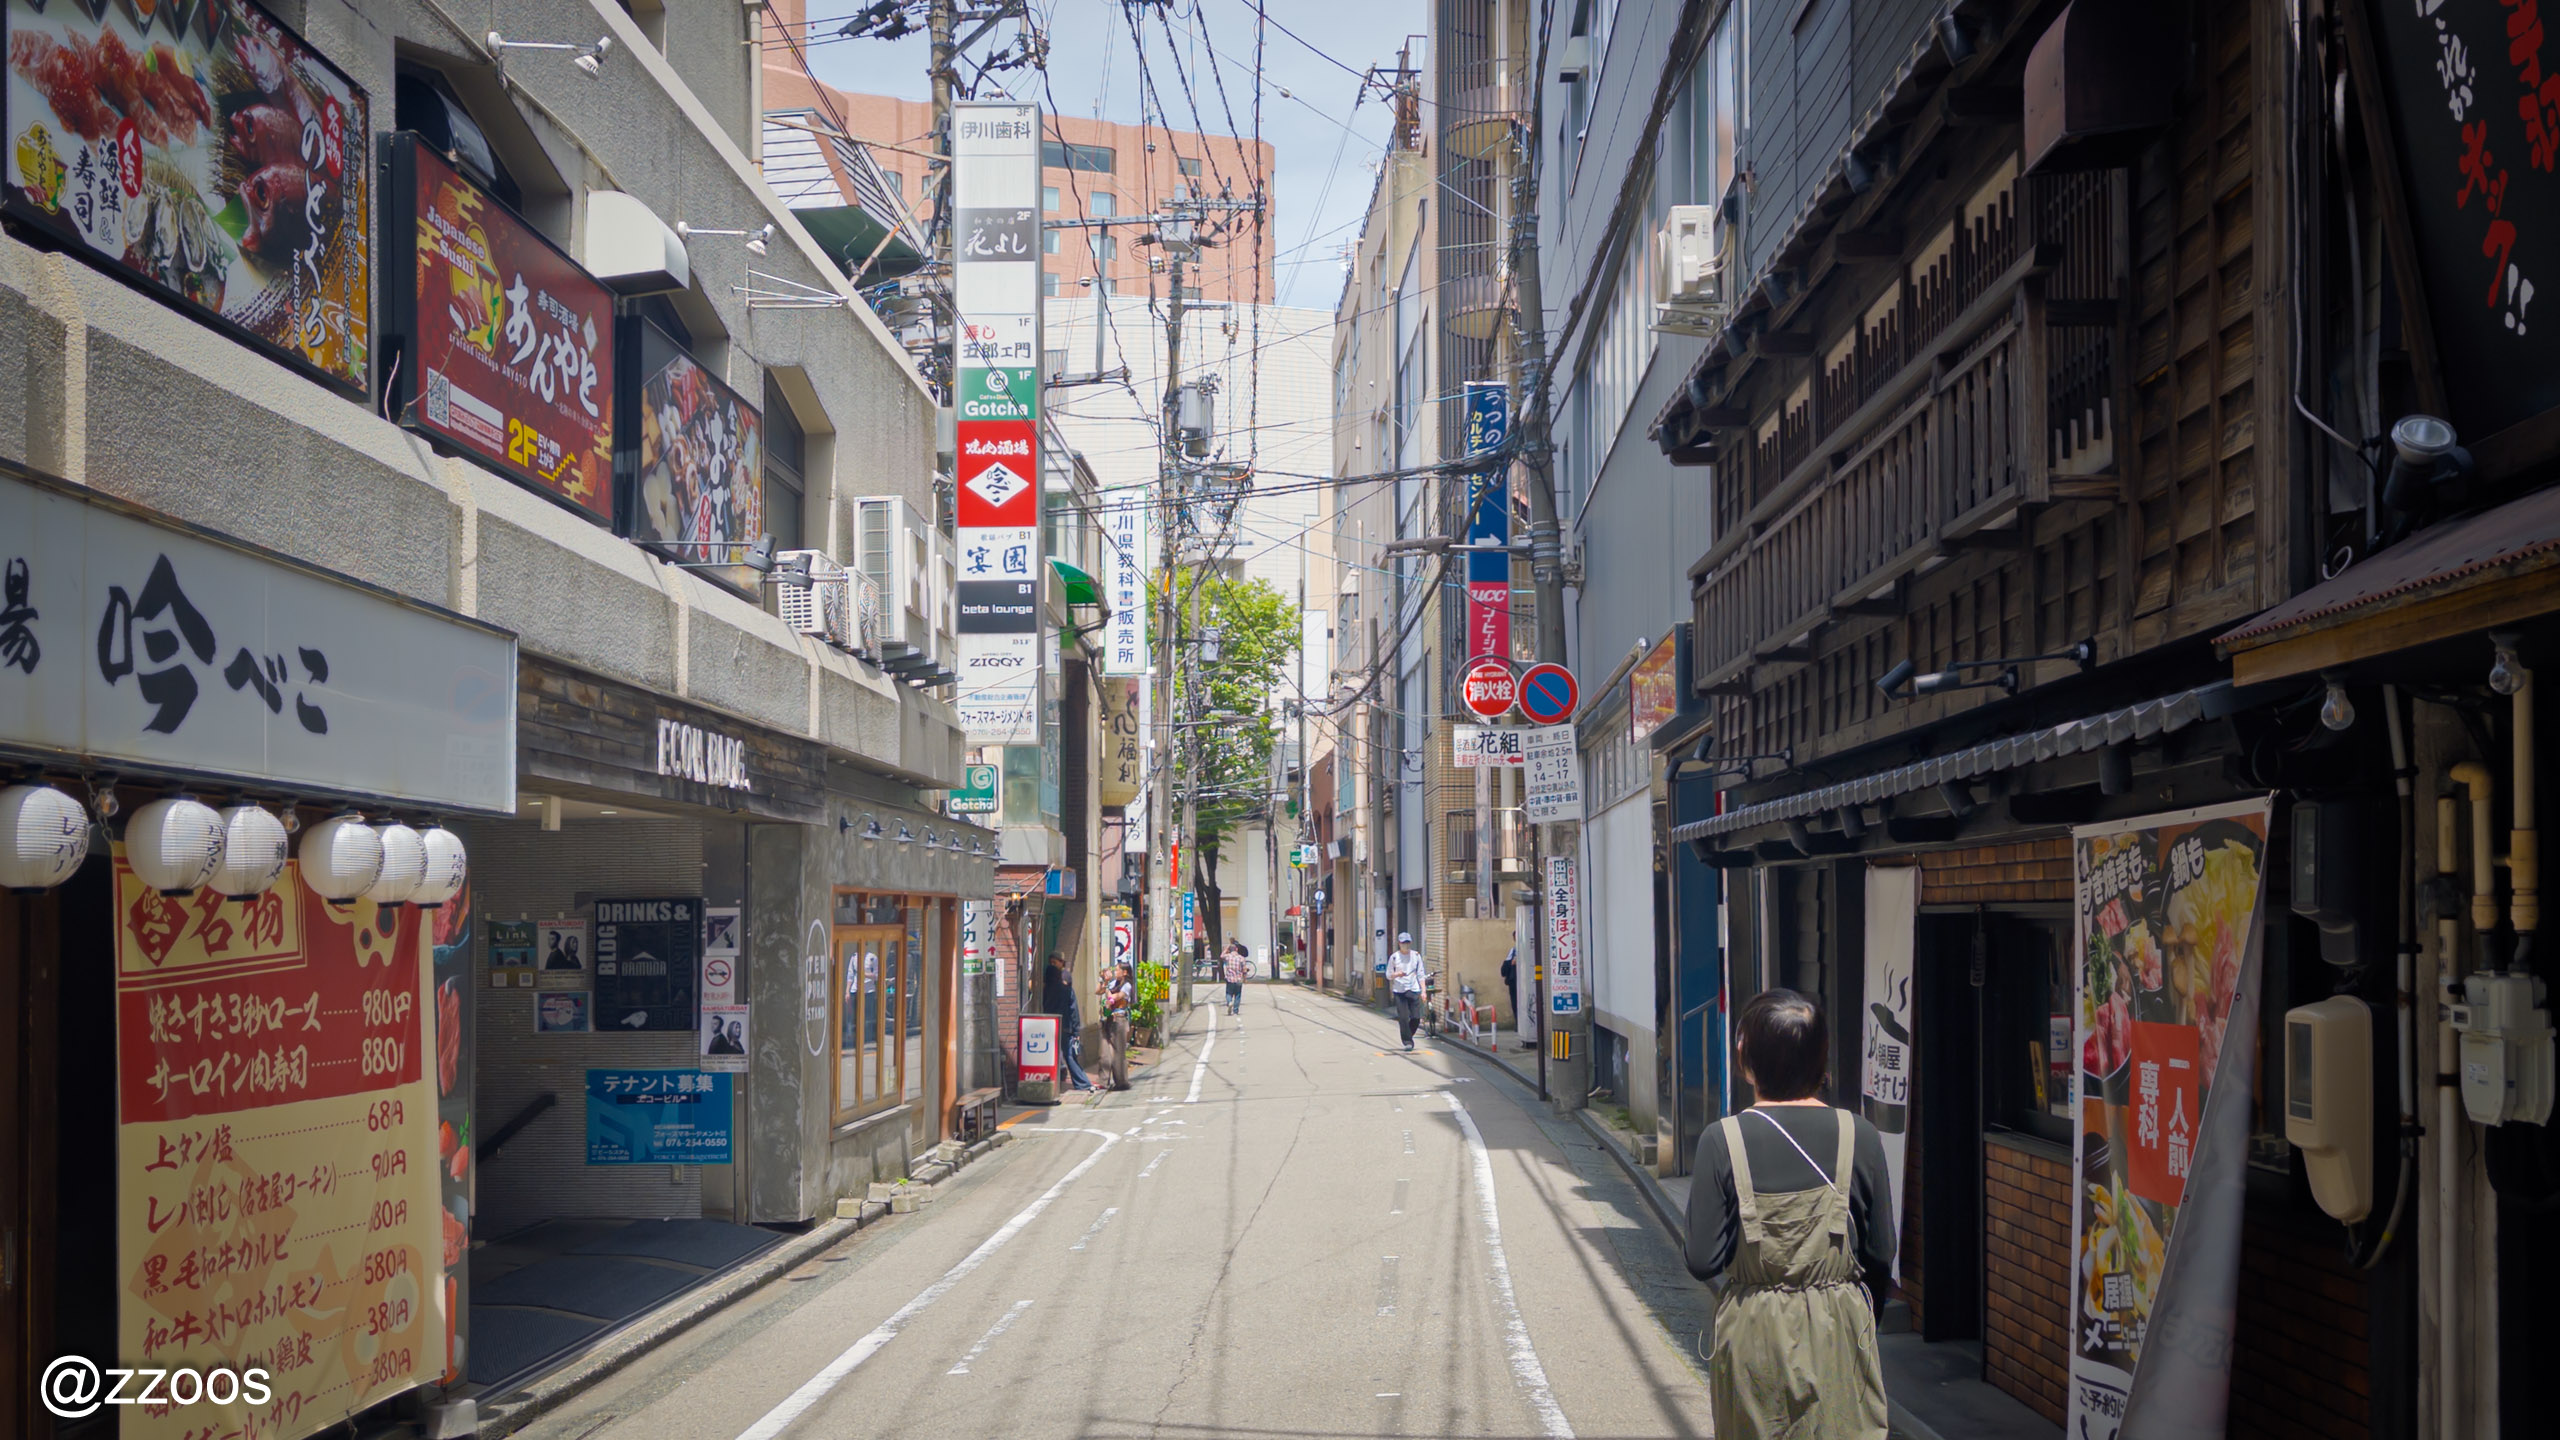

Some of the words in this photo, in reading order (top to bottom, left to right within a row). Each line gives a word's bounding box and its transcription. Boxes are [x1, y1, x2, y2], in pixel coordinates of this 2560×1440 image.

[960, 120, 1031, 139] 伊川歯科
[1016, 107, 1030, 117] 3F
[327, 103, 341, 170] 名物
[122, 127, 139, 192] 人気
[73, 145, 97, 234] 寿司
[301, 110, 327, 347] のどぐろ
[426, 205, 486, 260] Japanese
[1017, 211, 1031, 221] 2F
[439, 239, 475, 278] Sushi
[964, 228, 1027, 256] 花よし
[293, 248, 301, 345] NODOGURO
[1019, 317, 1031, 327] 1F
[505, 272, 600, 418] あんやと
[501, 364, 528, 389] ANYATO
[1018, 370, 1032, 381] 1F
[964, 400, 1029, 417] Gotcha
[508, 417, 538, 468] 2F
[986, 466, 1011, 503] 吟べこ
[1019, 531, 1031, 541] B1
[1019, 583, 1032, 594] B1
[962, 604, 990, 614] beta
[992, 604, 1034, 614] lounge
[98, 553, 329, 735] 吟べこ
[970, 657, 1025, 667] ZIGGY
[1469, 680, 1513, 702] 消火栓
[951, 797, 994, 811] Gotcha
[2170, 837, 2205, 890] 鍋も
[187, 885, 284, 958] 名物
[598, 902, 672, 922] DRINKS
[673, 904, 691, 921] &
[1555, 887, 1571, 976] 全身ほぐし屋
[496, 930, 528, 940] Link
[597, 924, 616, 976] BLDG
[149, 991, 322, 1043] 焼きすき3秒ロース
[361, 988, 412, 1030] 980円
[147, 1043, 308, 1105] サーロイン肉寿司
[361, 1036, 405, 1077] 880
[603, 1074, 714, 1093] テナント募集
[2168, 1057, 2191, 1180] 一人前
[145, 1123, 234, 1173] 上タン塩
[142, 1227, 291, 1300] 黒毛和牛カルビ
[364, 1247, 407, 1286] 580円
[367, 1297, 409, 1336] 380円
